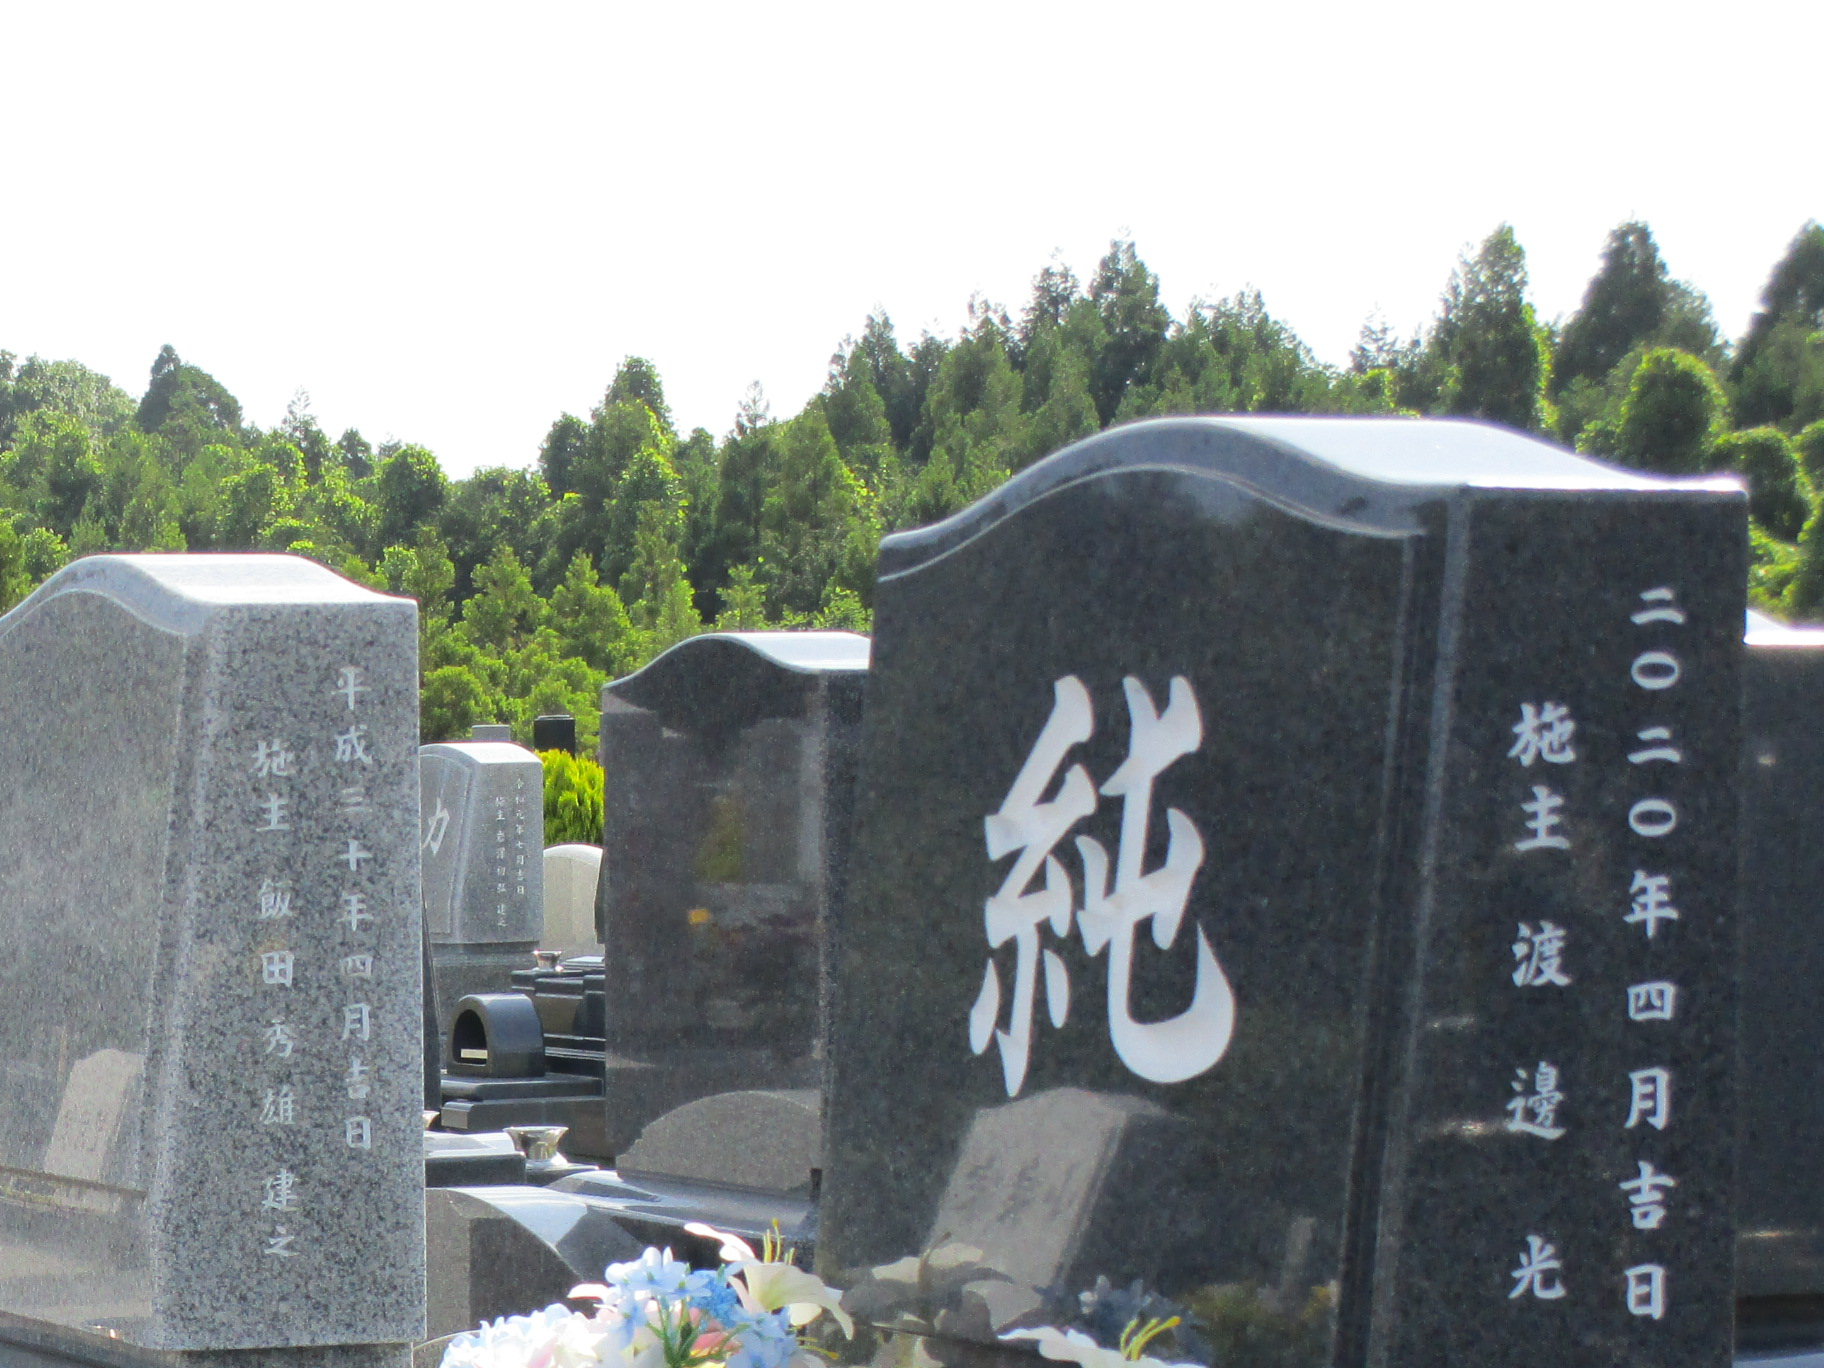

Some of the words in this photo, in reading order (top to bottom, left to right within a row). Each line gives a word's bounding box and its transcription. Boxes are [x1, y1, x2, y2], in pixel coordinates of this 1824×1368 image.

[330, 666, 375, 1153] 平成三十年四月吉日
[969, 673, 1236, 1098] 純
